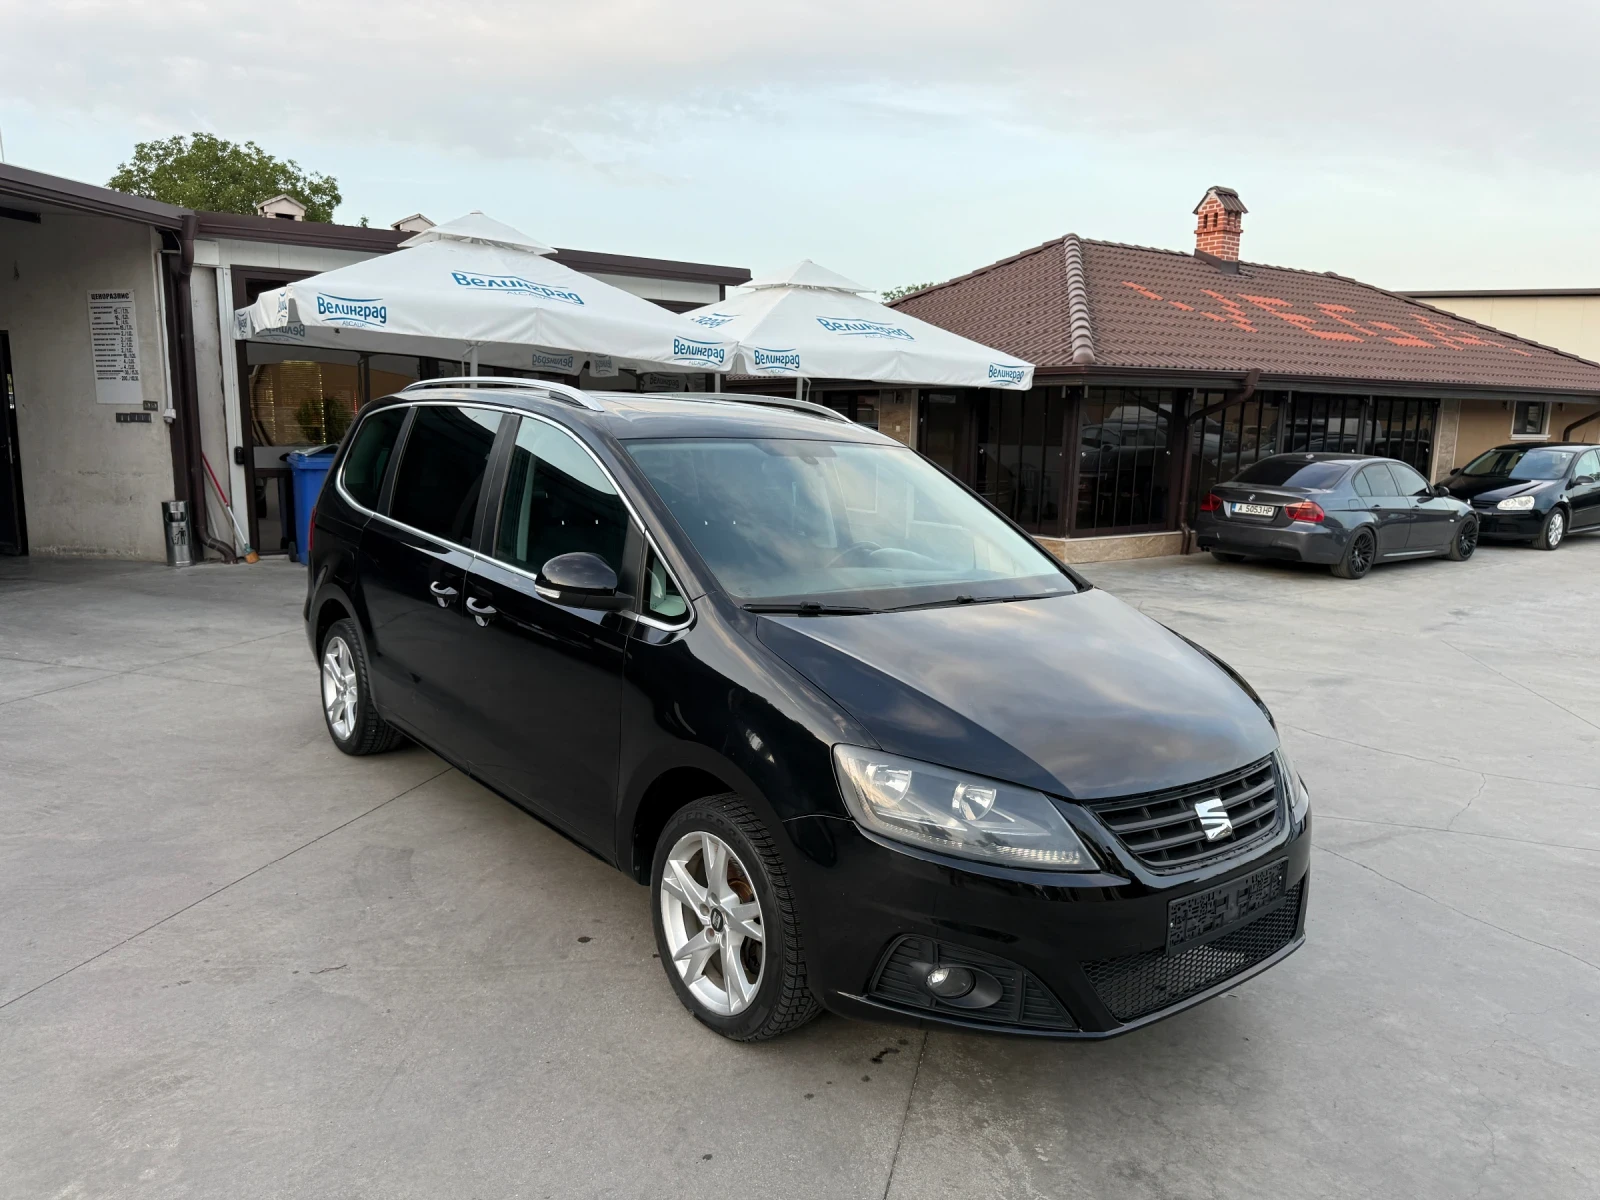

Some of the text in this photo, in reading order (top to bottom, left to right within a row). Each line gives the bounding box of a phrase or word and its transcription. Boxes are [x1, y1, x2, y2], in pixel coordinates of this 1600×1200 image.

[451, 272, 585, 305] Велинград
[317, 295, 387, 325] Велинград
[816, 317, 915, 341] Велинград
[673, 338, 725, 363] Велинград
[754, 349, 800, 369] Велинград
[988, 364, 1025, 383] Велинград
